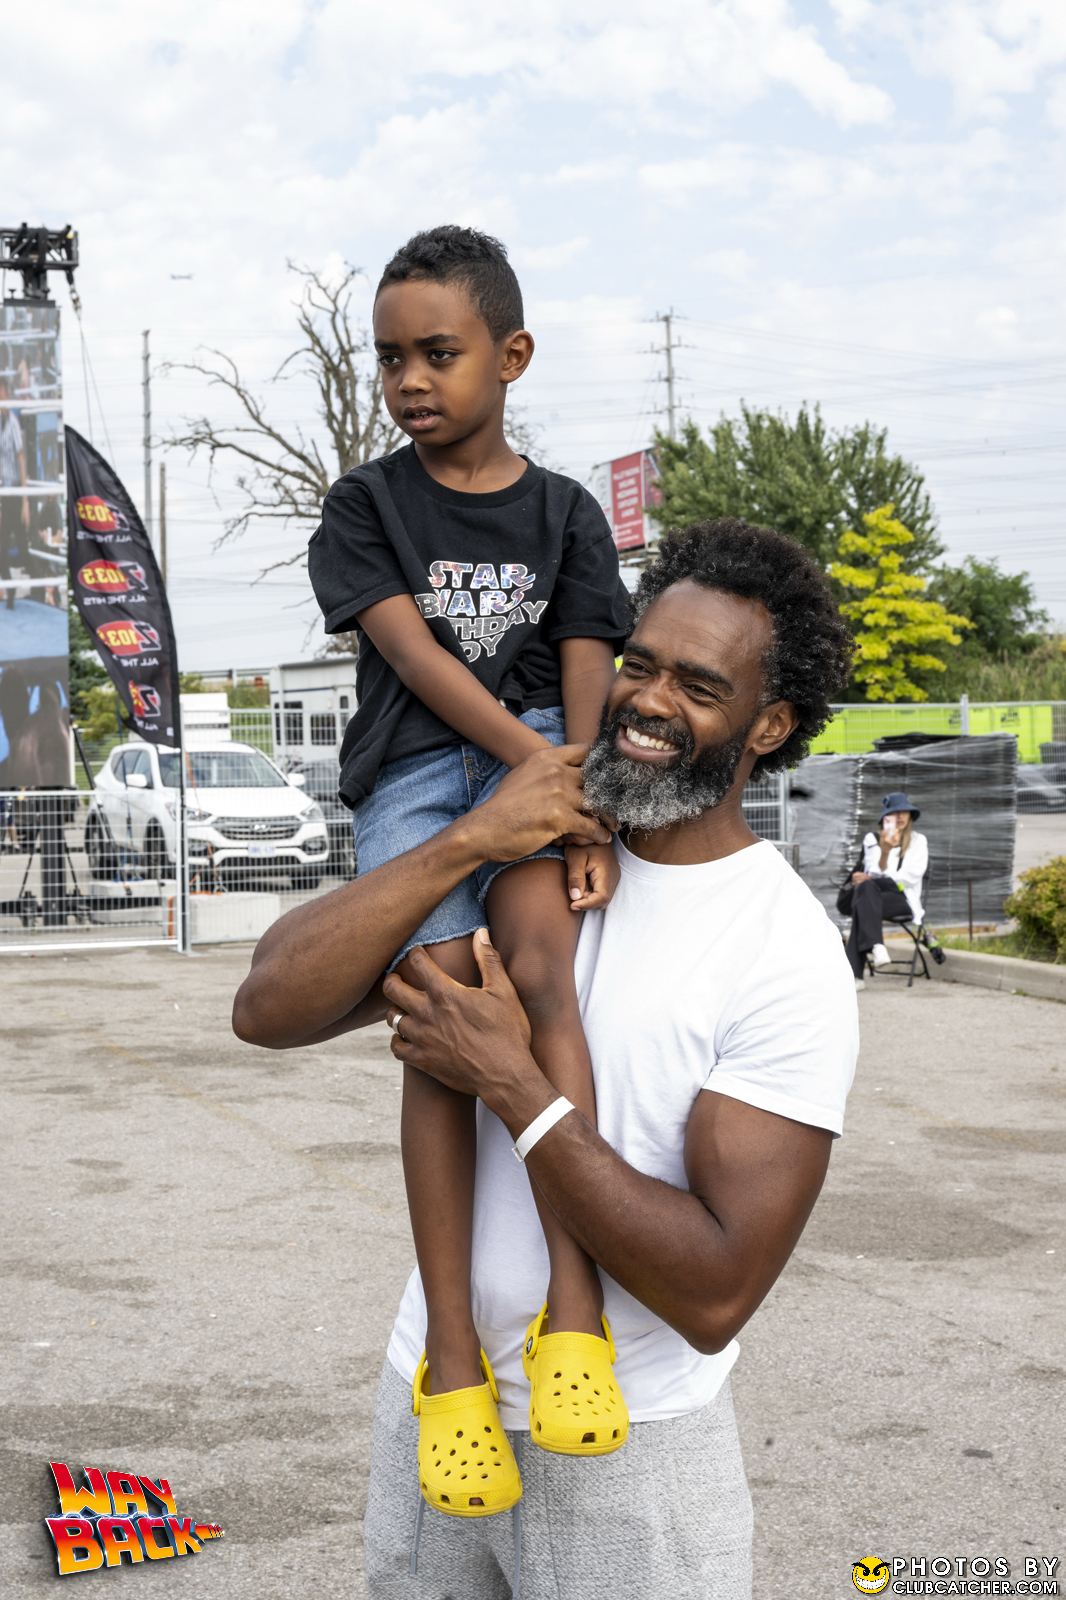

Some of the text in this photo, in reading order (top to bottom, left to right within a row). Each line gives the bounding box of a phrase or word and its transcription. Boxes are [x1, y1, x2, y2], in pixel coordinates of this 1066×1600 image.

[428, 560, 536, 589] STAR
[415, 592, 548, 640] BTHDAY
[459, 632, 505, 663] OY
